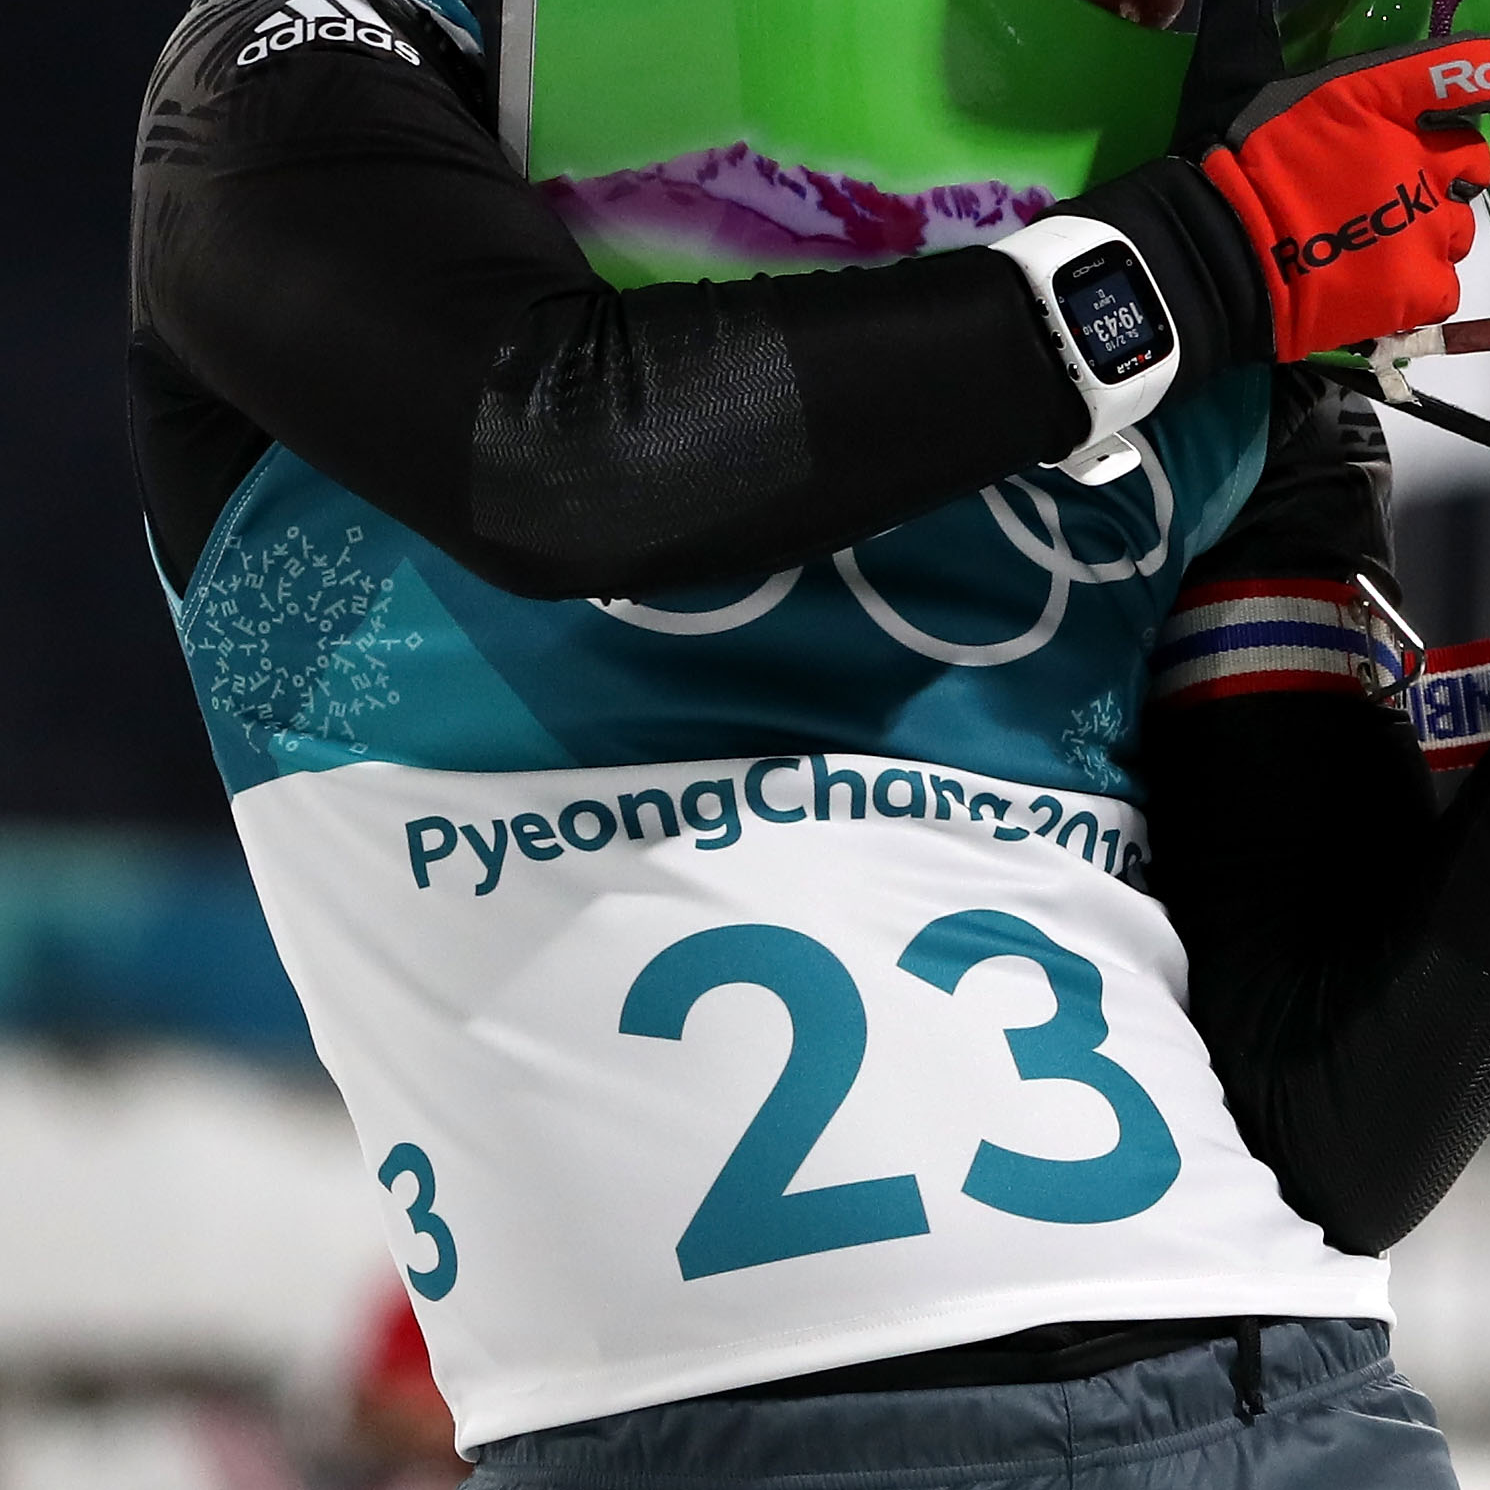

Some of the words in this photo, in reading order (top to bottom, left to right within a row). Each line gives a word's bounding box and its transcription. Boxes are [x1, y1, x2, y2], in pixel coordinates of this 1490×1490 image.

[236, 17, 421, 66] adidas
[1093, 302, 1144, 342] 19:43
[1117, 350, 1152, 374] POLAR
[406, 753, 1030, 896] PyeongChang
[618, 909, 1182, 1281] 23
[377, 1142, 458, 1302] 3
